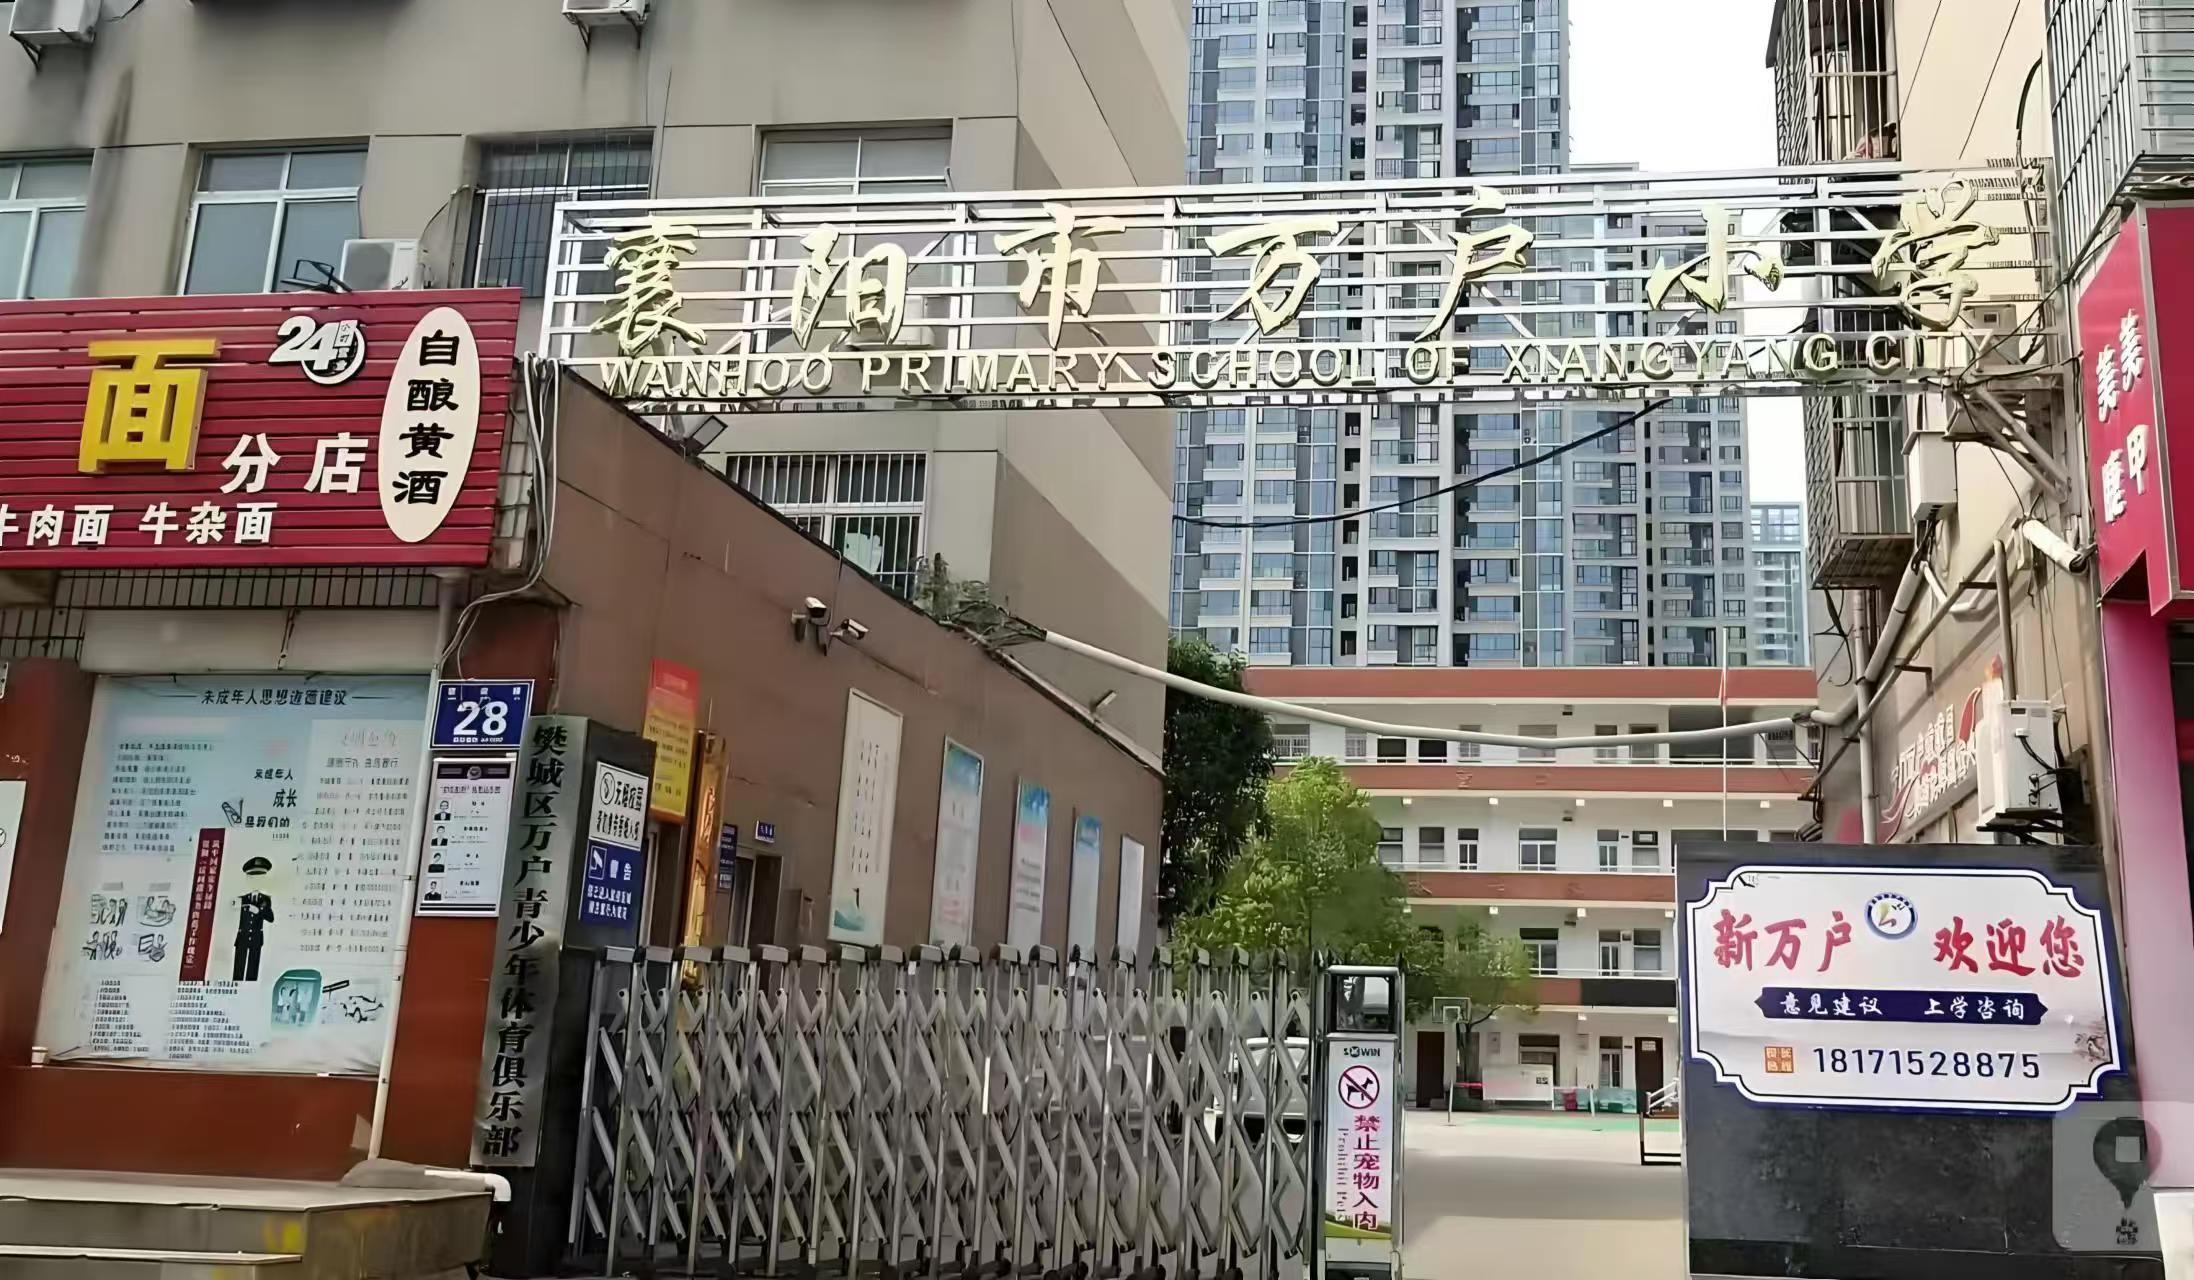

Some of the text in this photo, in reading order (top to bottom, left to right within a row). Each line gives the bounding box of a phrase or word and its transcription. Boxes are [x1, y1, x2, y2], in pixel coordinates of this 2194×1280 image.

[268, 315, 341, 371] 24
[599, 328, 1994, 397] WANHOO PRIMARY SCHOOL OF XIANGYANG CITY
[78, 338, 220, 474] 面
[391, 328, 461, 506] 自酿黄酒
[220, 431, 368, 495] 分店
[138, 500, 279, 545] 牛杂面
[453, 700, 509, 736] 28
[273, 788, 297, 808] 成长
[482, 724, 569, 1158] 樊城区万户青少年体育俱乐部
[1713, 909, 2085, 978] 新万户 欢迎您
[1779, 992, 2026, 1021] 意见建议 上学咨询
[1813, 1047, 2041, 1079] 18171528875
[1352, 1115, 1381, 1232] 禁止宠物入内
